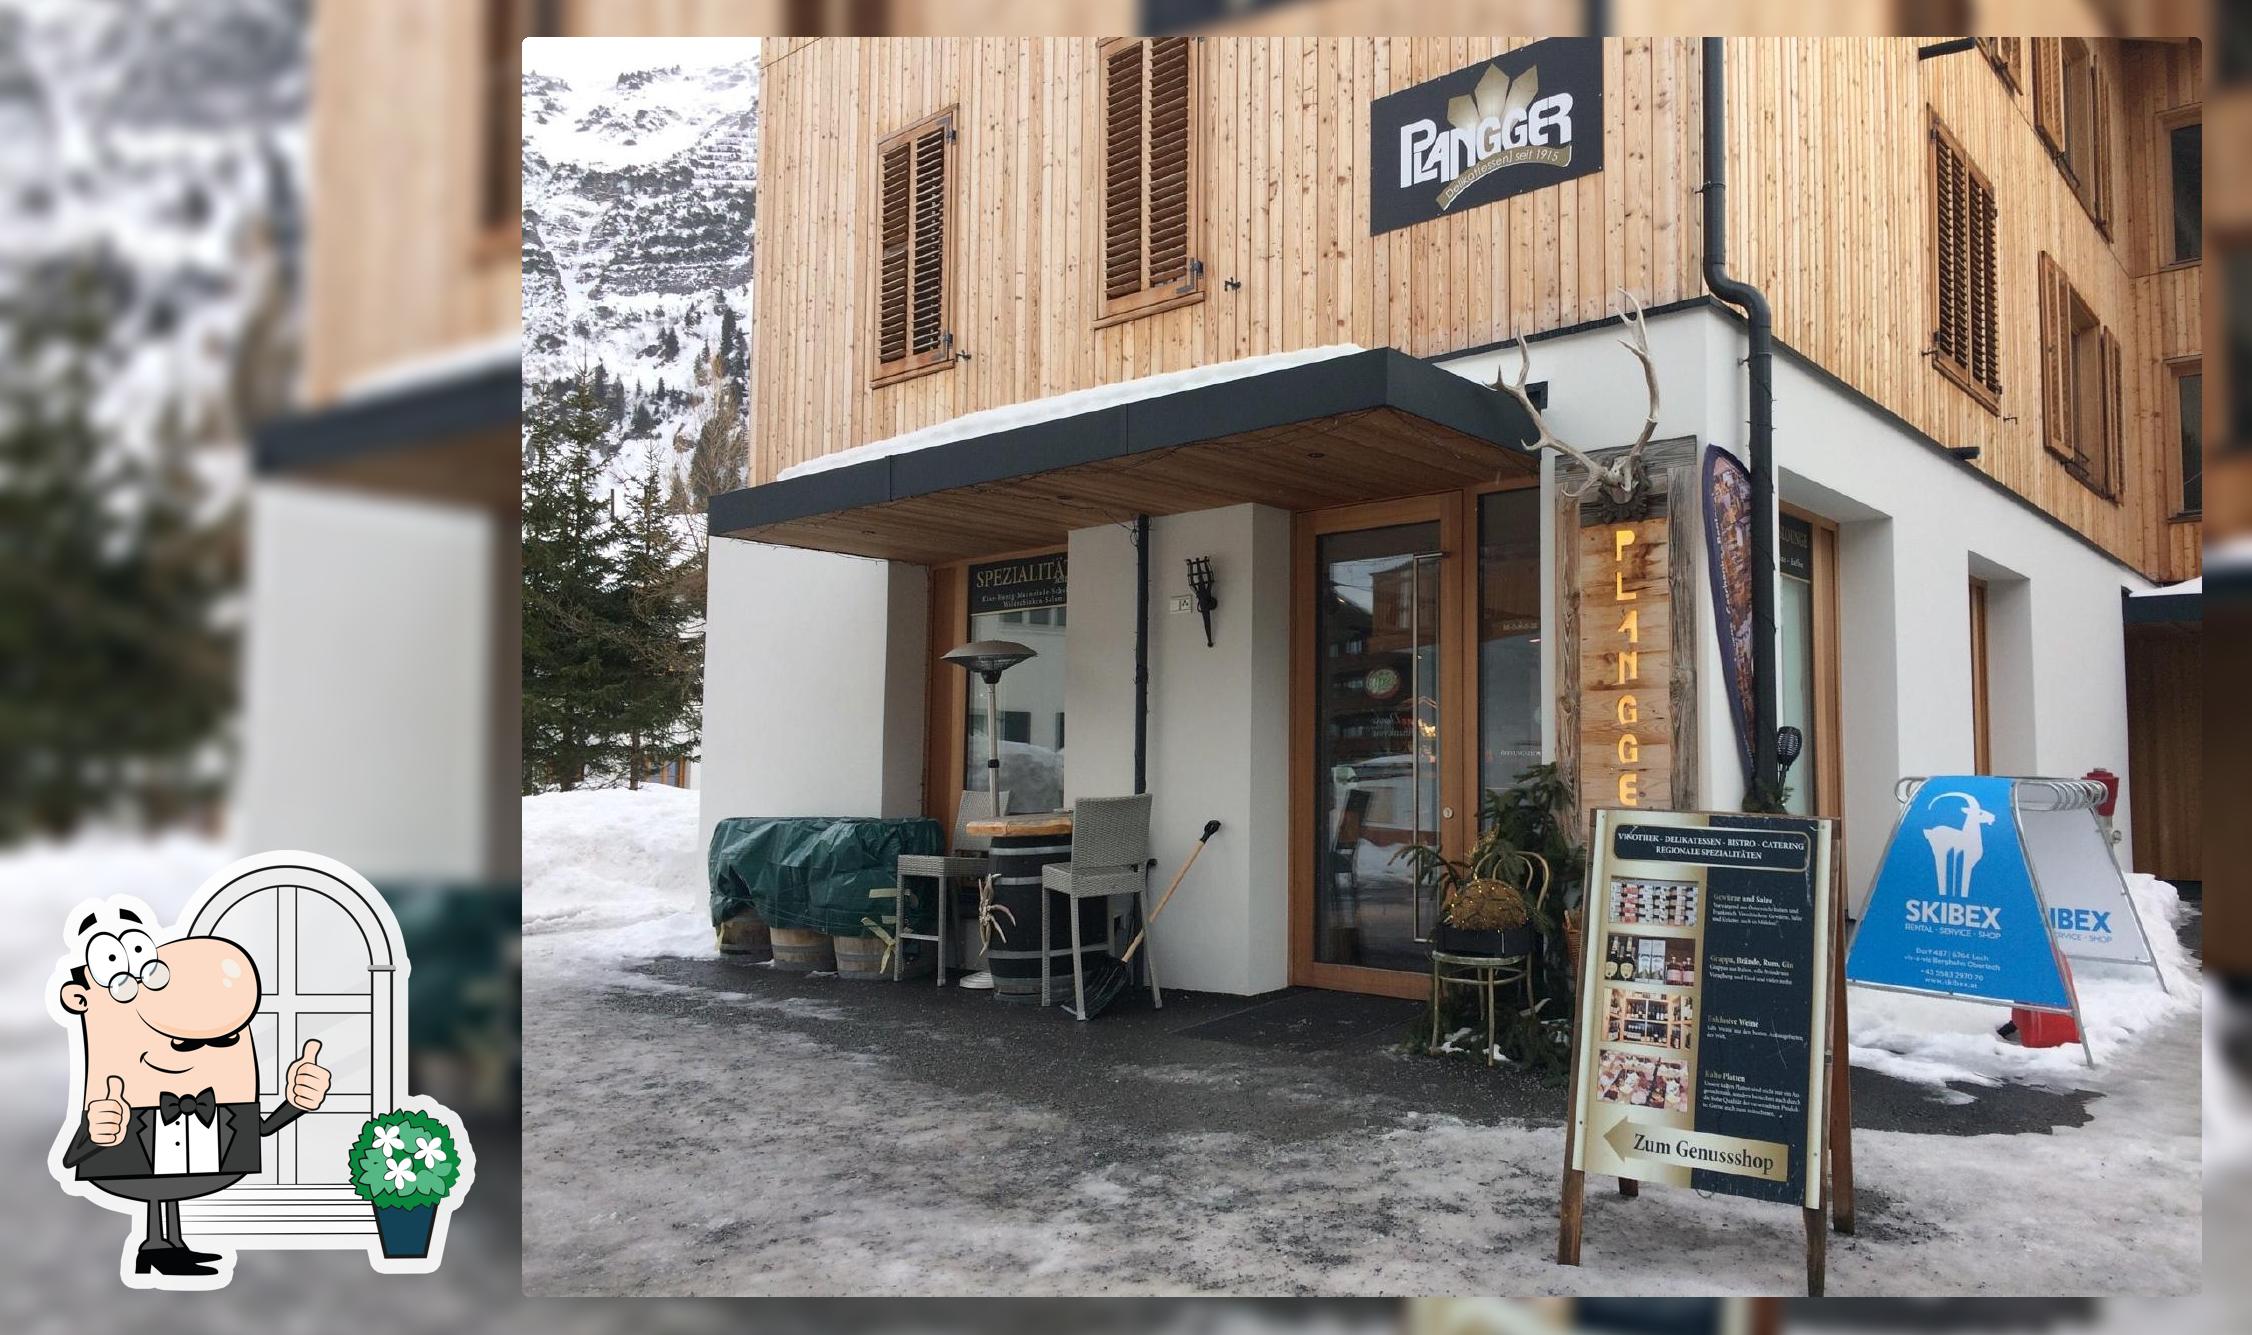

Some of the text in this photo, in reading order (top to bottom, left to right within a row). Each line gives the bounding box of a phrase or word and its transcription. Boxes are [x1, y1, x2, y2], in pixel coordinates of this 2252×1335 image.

[1400, 92, 1574, 188] PLANGGER
[1515, 149, 1532, 160] seit
[1535, 148, 1560, 161] 1915
[1616, 530, 1638, 806] PLANGGE
[1618, 833, 1805, 851] VINOTHEK DELIKATESSEN BISTRO CATERING
[1656, 846, 1762, 860] REGIONALE SPEZIALITÄTEN
[1905, 899, 2001, 930] SKIBEX
[2049, 908, 2113, 933] IBEX
[1905, 923, 2001, 939] RENTAL SERVICE SHOP
[1782, 960, 1794, 969] Gin
[1634, 1133, 1774, 1175] Zum Genussshop
